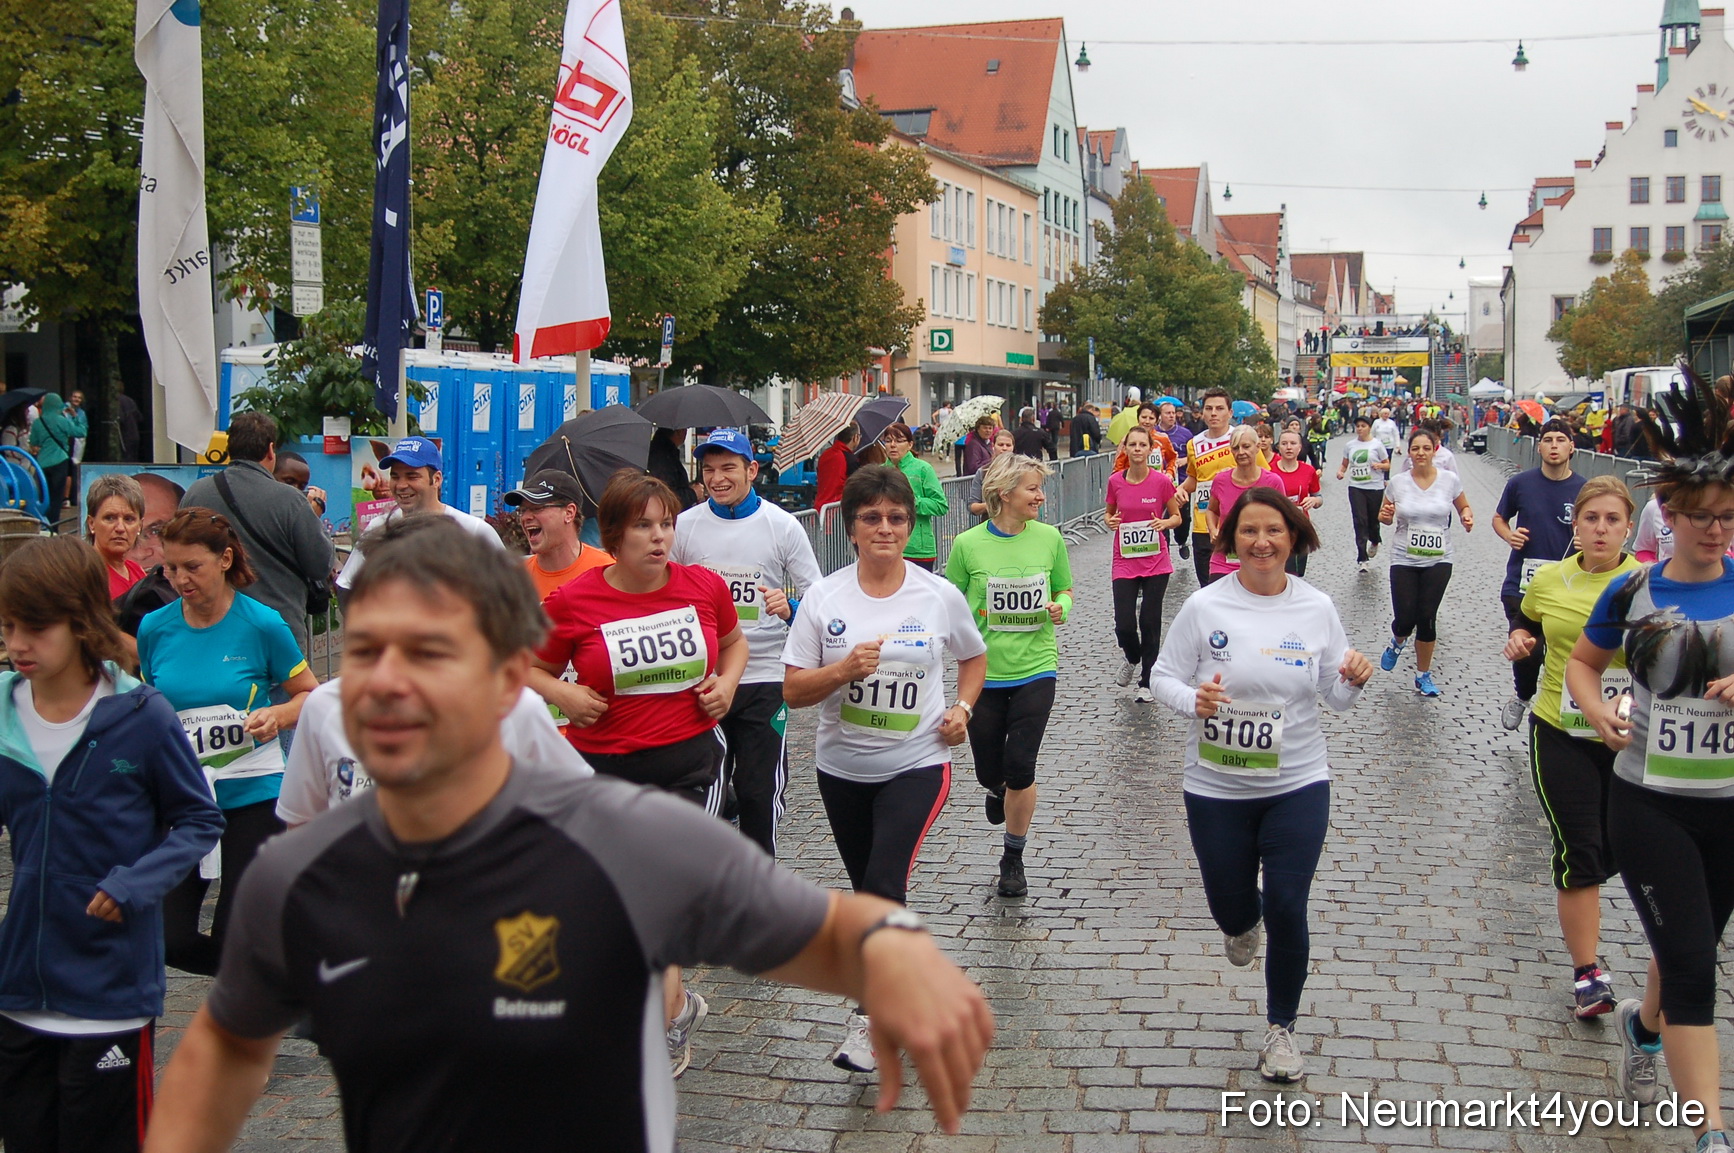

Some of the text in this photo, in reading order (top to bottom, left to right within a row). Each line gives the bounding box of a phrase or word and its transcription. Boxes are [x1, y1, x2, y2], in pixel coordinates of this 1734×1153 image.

[430, 295, 439, 323] P
[665, 320, 672, 342] P
[933, 332, 950, 349] D
[1362, 356, 1395, 364] START
[1196, 455, 1215, 468] MAX
[1123, 529, 1155, 545] 5027
[1411, 533, 1442, 548] 5030
[1010, 581, 1038, 589] Neumarkt
[993, 589, 1043, 610] 5002
[605, 618, 682, 637] PARTL Neumarkt
[1000, 616, 1038, 625] Walburga
[618, 627, 697, 668] 5058
[637, 669, 687, 684] Jennifer
[848, 679, 918, 710] 5110
[1227, 708, 1268, 717] Neumarkt
[1653, 703, 1733, 718] PARTL Neumarkt
[182, 712, 235, 726] RTL Neumarkt
[871, 714, 888, 726] Evi
[186, 724, 244, 754] 180
[1204, 715, 1273, 750] 5108
[1658, 718, 1734, 754] 5148
[1222, 754, 1248, 767] gaby
[495, 998, 566, 1017] Betreuer
[97, 1058, 130, 1068] adidas
